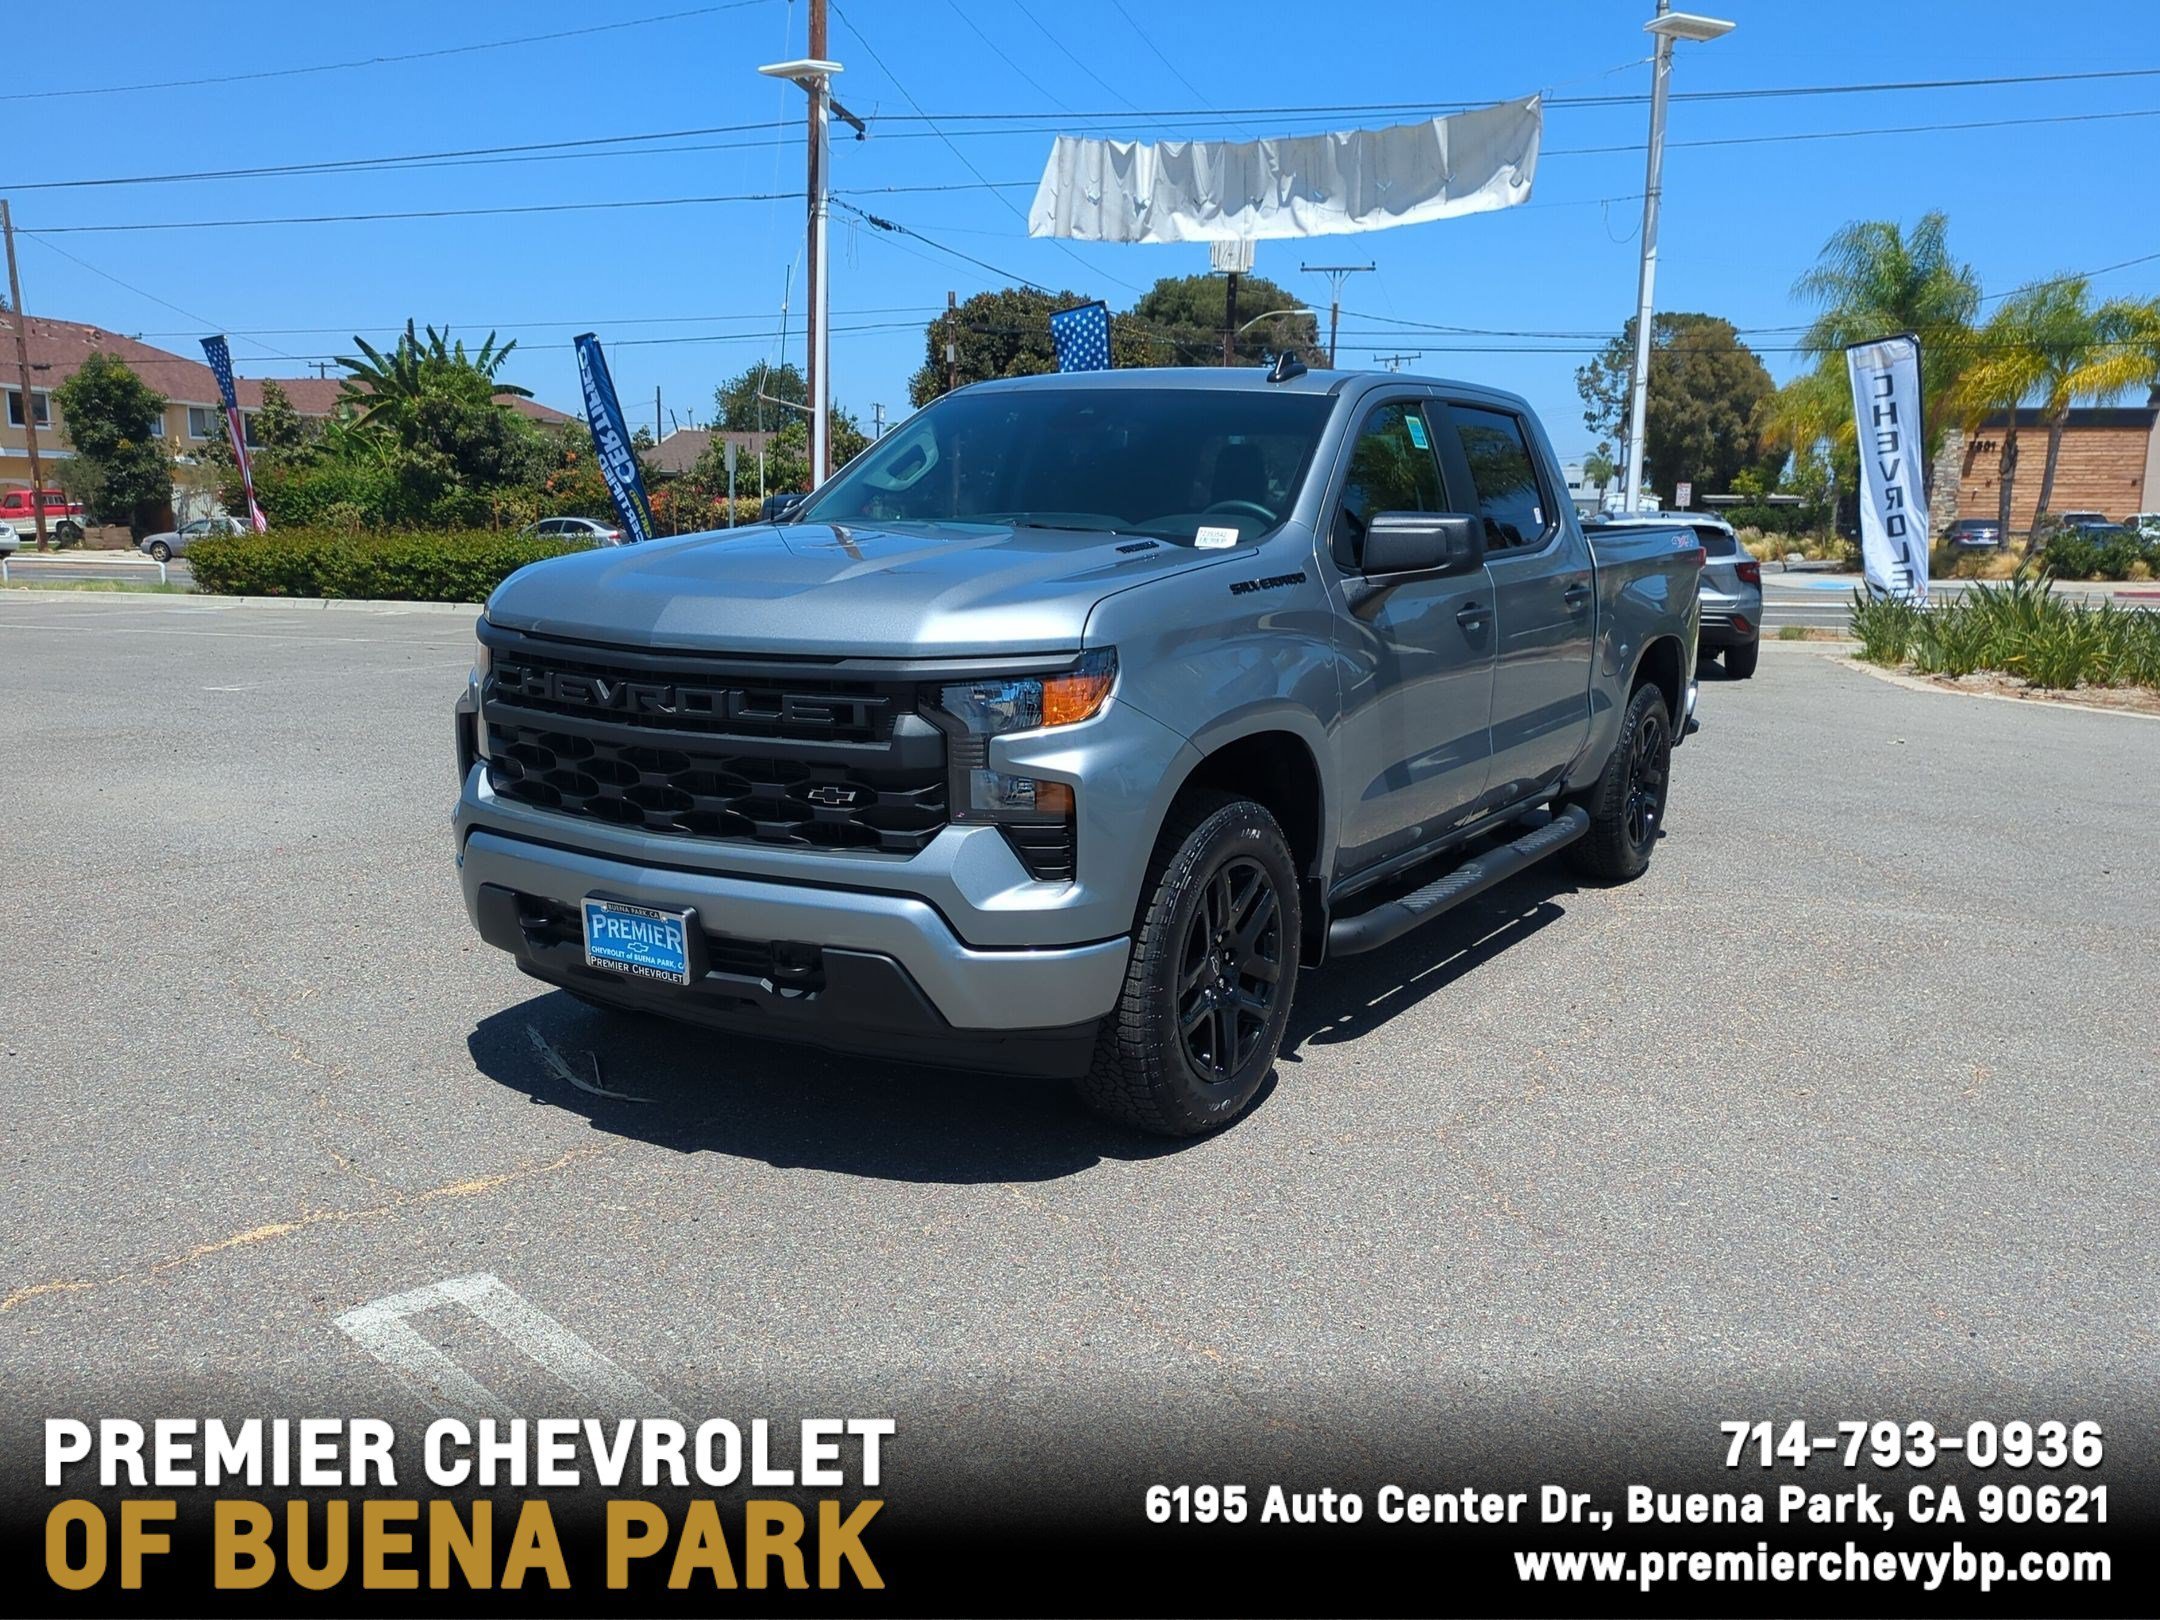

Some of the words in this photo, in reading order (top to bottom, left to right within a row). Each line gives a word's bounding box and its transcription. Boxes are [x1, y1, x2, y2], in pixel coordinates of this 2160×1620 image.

[493, 663, 891, 727] CHEVROLET
[591, 914, 683, 955] PREMIER
[590, 956, 630, 972] PREMIER
[632, 967, 684, 983] CHEVROLET
[591, 946, 625, 959] CHEVROLET
[634, 954, 656, 966] BUENA
